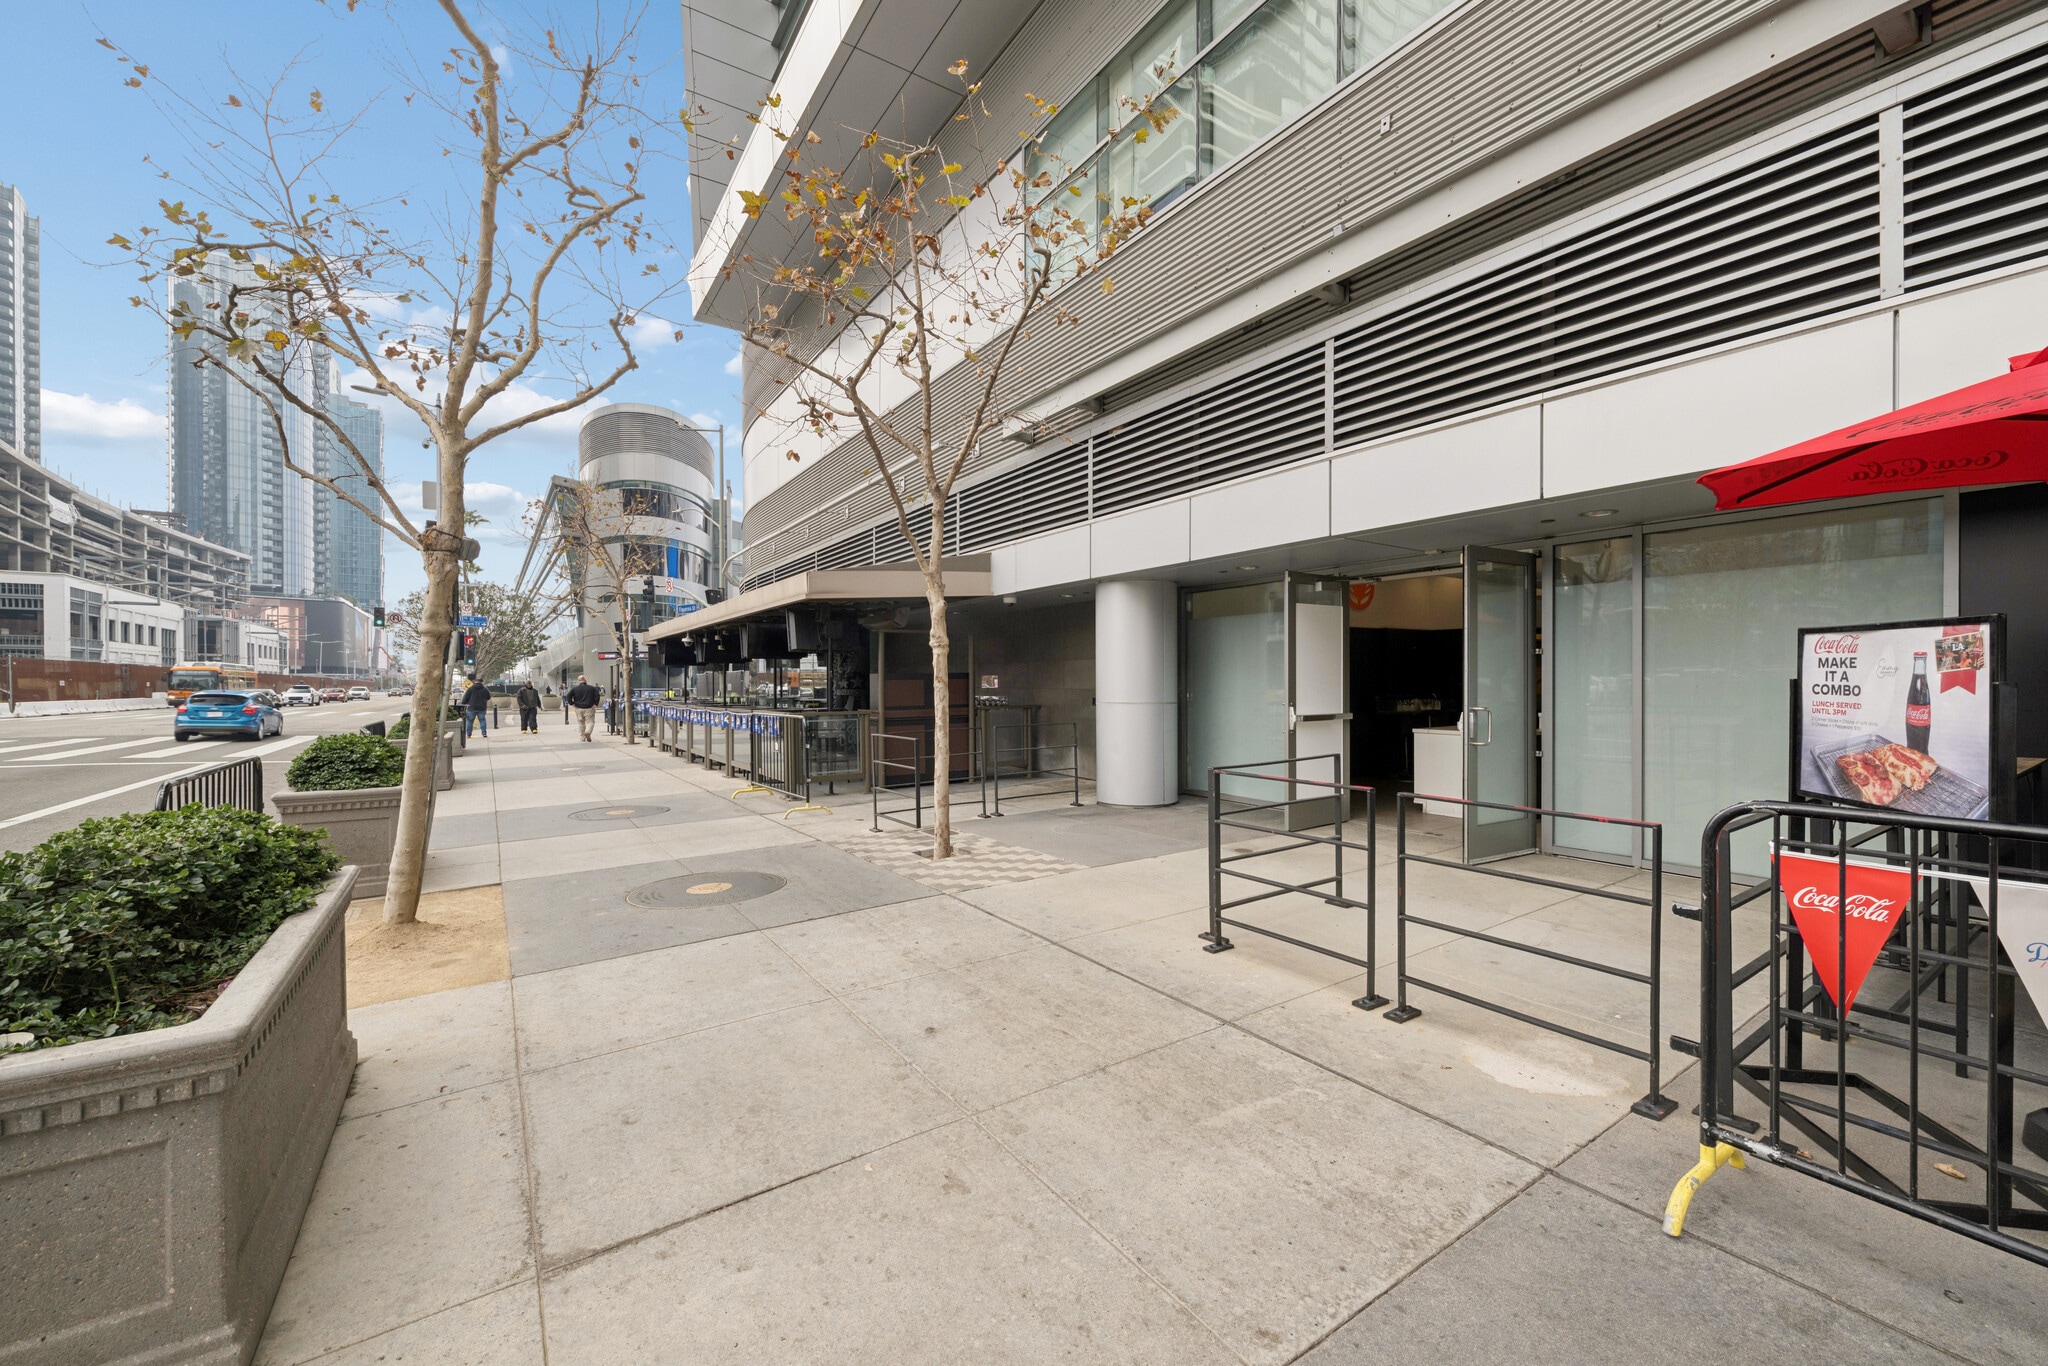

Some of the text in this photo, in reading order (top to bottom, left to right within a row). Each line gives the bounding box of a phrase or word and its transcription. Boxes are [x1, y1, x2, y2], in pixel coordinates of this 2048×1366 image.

[1814, 634, 1861, 655] Coca-Cola
[1818, 657, 1857, 669] MAKE
[1825, 671, 1849, 682] IT A
[1812, 684, 1861, 696] COMBO
[1906, 707, 1929, 720] Coca-Cola
[1793, 886, 1896, 922] CocaCola
